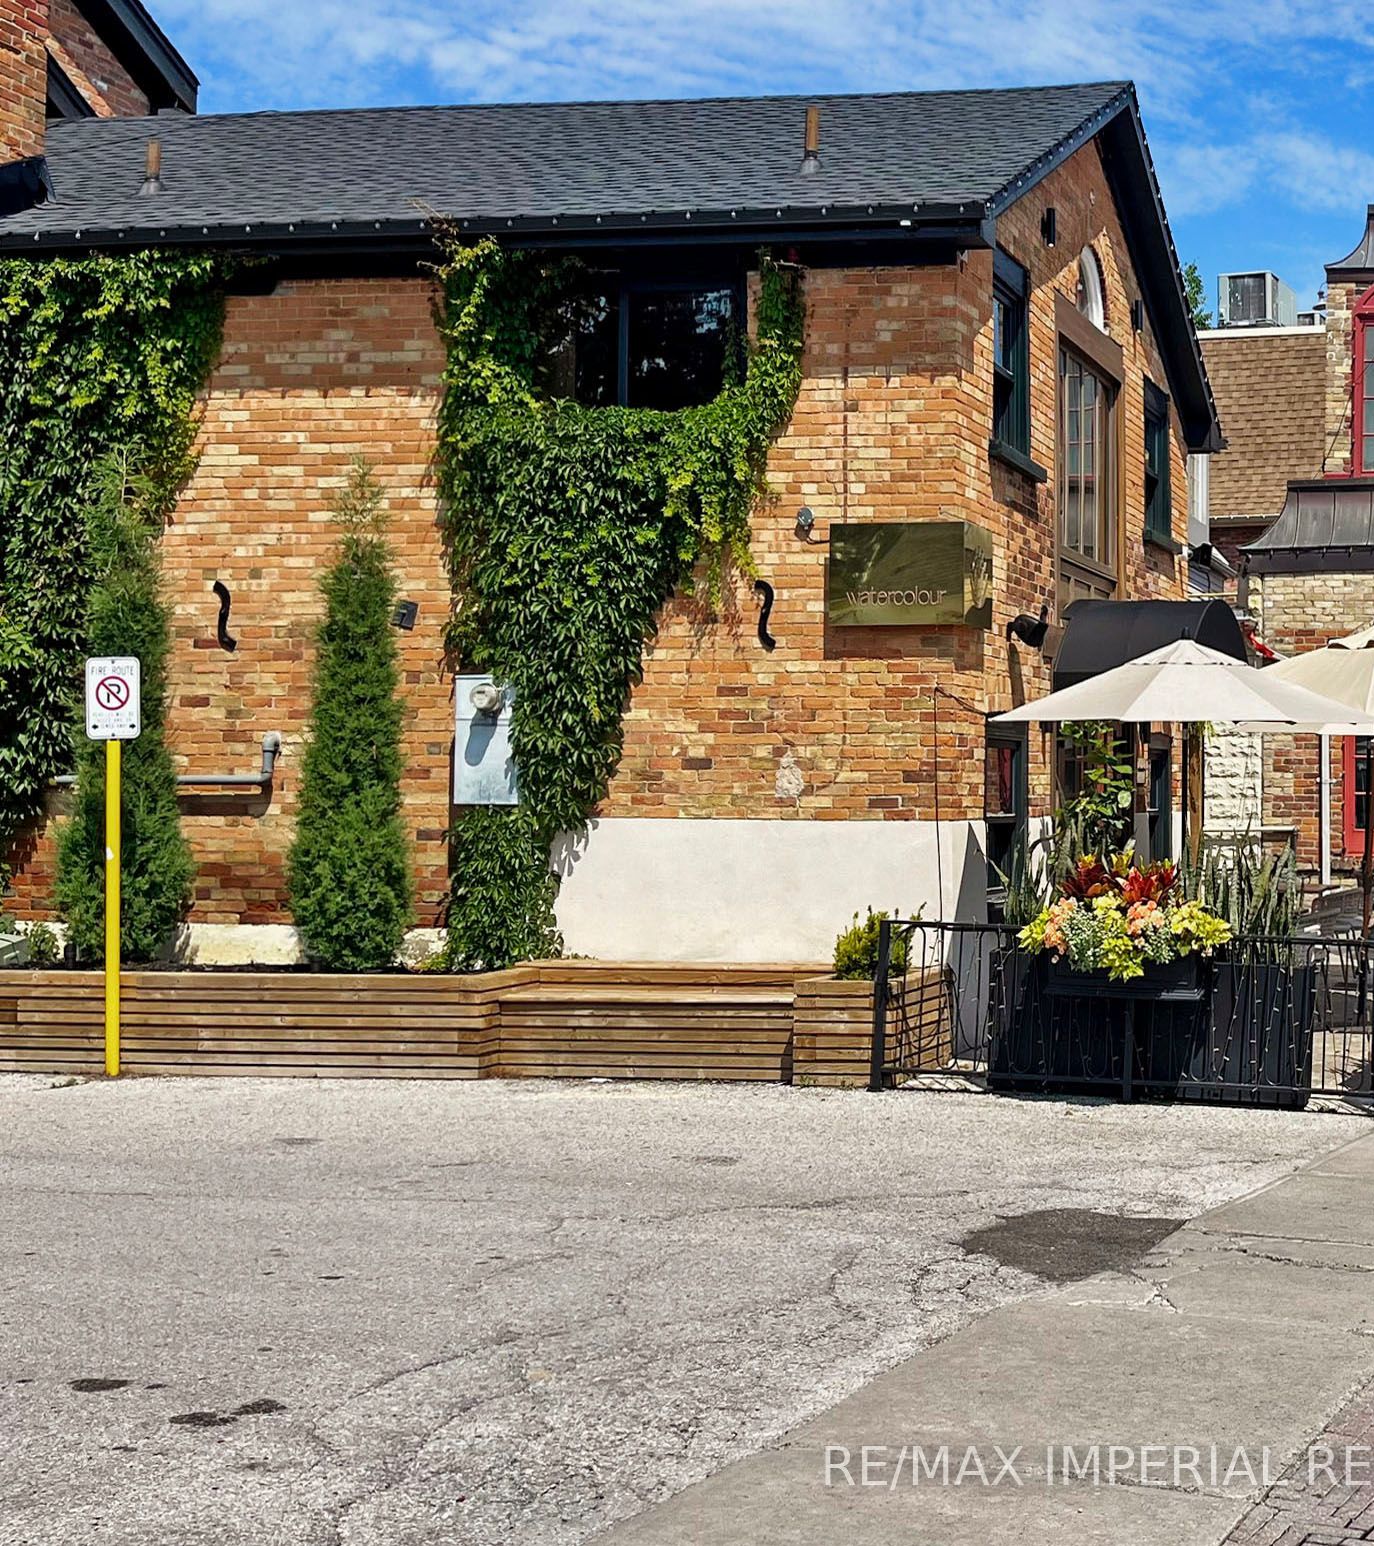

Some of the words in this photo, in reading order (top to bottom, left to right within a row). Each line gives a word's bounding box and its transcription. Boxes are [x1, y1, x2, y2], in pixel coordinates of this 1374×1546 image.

[846, 586, 947, 606] watercolour
[91, 665, 106, 676] FIRE
[112, 665, 134, 676] ROUTE
